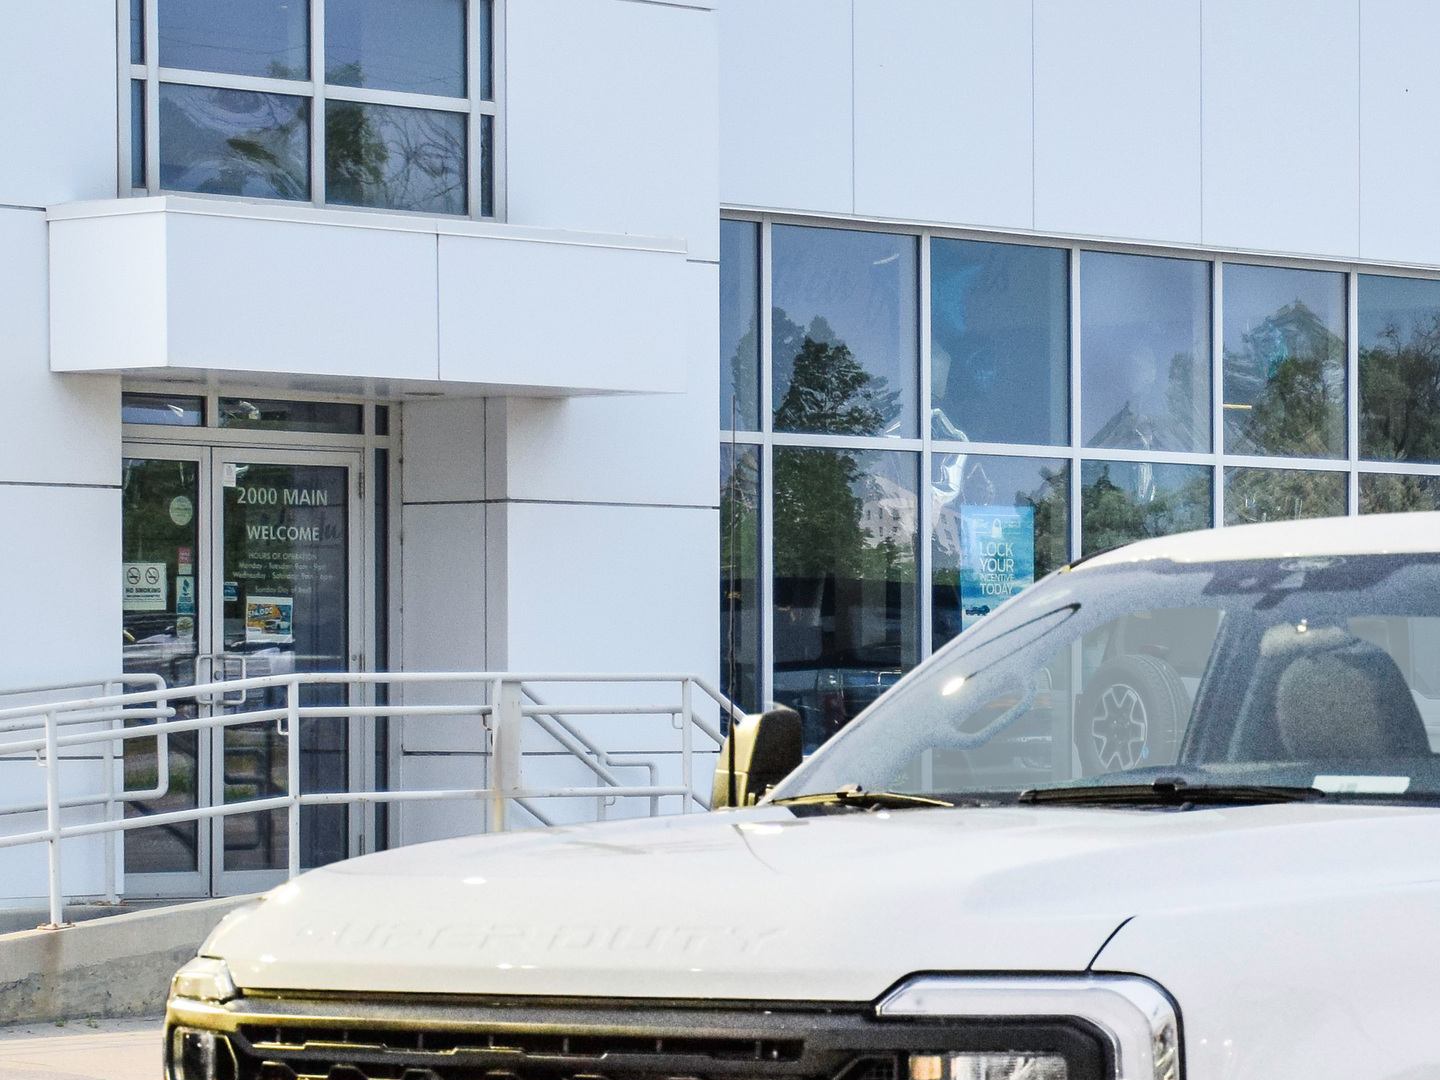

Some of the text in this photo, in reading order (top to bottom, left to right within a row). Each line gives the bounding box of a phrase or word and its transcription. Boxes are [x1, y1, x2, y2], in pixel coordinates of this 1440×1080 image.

[237, 487, 328, 506] 2000 MAIN
[246, 525, 320, 541] WELCOME
[980, 541, 1014, 557] LOCK
[248, 552, 317, 560] HOURS OF OPERATION
[239, 561, 262, 571] Monday
[980, 558, 1014, 573] YOUR
[232, 571, 266, 580] Wednesday
[255, 585, 276, 595] Sunday
[277, 586, 289, 595] Day
[980, 583, 1014, 595] TODAY
[545, 923, 789, 954] DUTY
